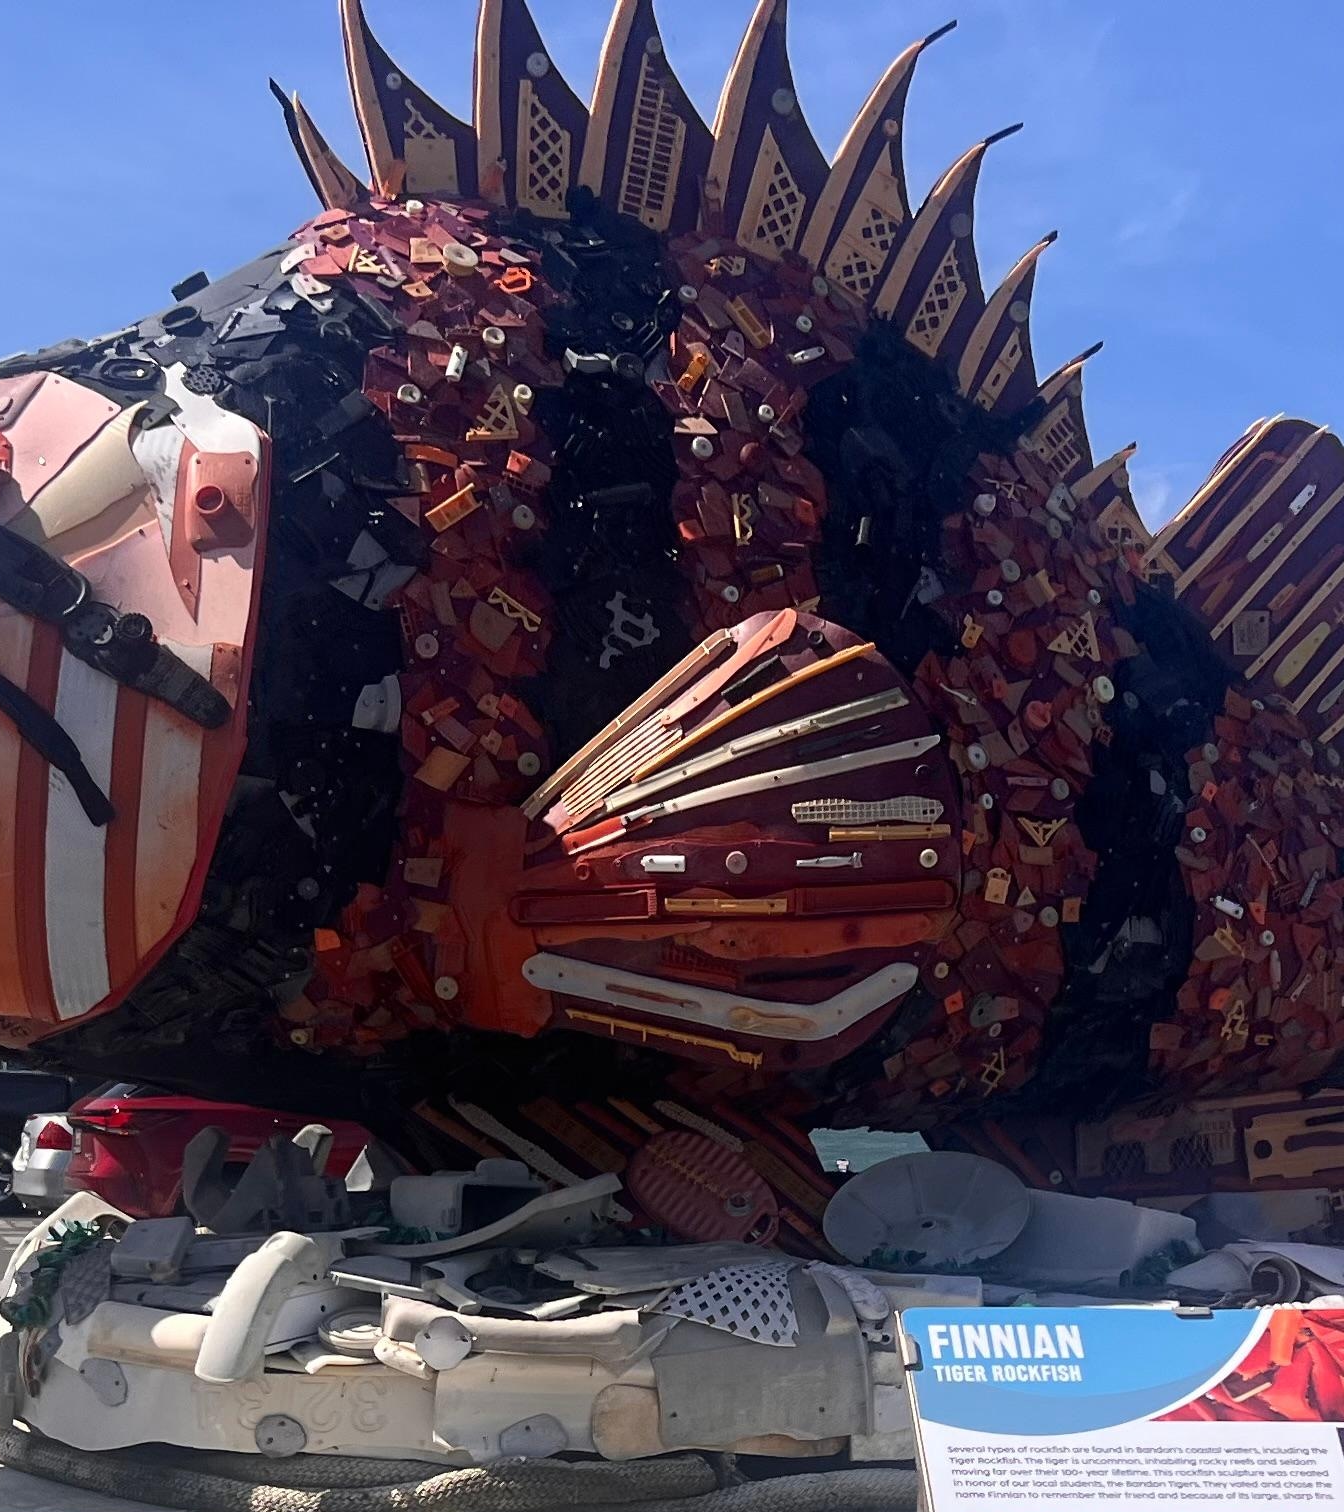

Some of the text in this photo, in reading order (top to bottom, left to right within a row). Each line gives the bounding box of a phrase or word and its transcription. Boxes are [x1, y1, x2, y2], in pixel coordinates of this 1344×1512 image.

[928, 1324, 1084, 1359] FINNIAN
[933, 1364, 1082, 1382] TIGER ROCKFISH
[987, 1446, 1016, 1454] types
[1029, 1445, 1071, 1453] rockfish
[1091, 1446, 1123, 1454] found
[1124, 1446, 1135, 1454] in
[1262, 1447, 1310, 1456] including
[949, 1457, 975, 1465] Tiger
[1024, 1457, 1044, 1465] The
[1044, 1457, 1069, 1466] tiger
[1070, 1457, 1080, 1465] is
[1144, 1458, 1198, 1466] inhabiting
[1198, 1458, 1228, 1466] rocky
[951, 1468, 991, 1477] moving
[992, 1468, 1007, 1476] far
[1035, 1468, 1059, 1476] their
[1153, 1469, 1174, 1477] This
[1175, 1468, 1216, 1477] rockfish
[1217, 1469, 1265, 1477] sculpture
[999, 1479, 1010, 1487] of
[1126, 1480, 1167, 1488] Bandon
[1202, 1481, 1227, 1489] They
[987, 1491, 1027, 1499] Finnian
[1124, 1491, 1156, 1499] friend
[1157, 1492, 1180, 1500] and
[1180, 1492, 1224, 1500] because
[1225, 1491, 1237, 1500] of
[1282, 1492, 1314, 1501] sharp
